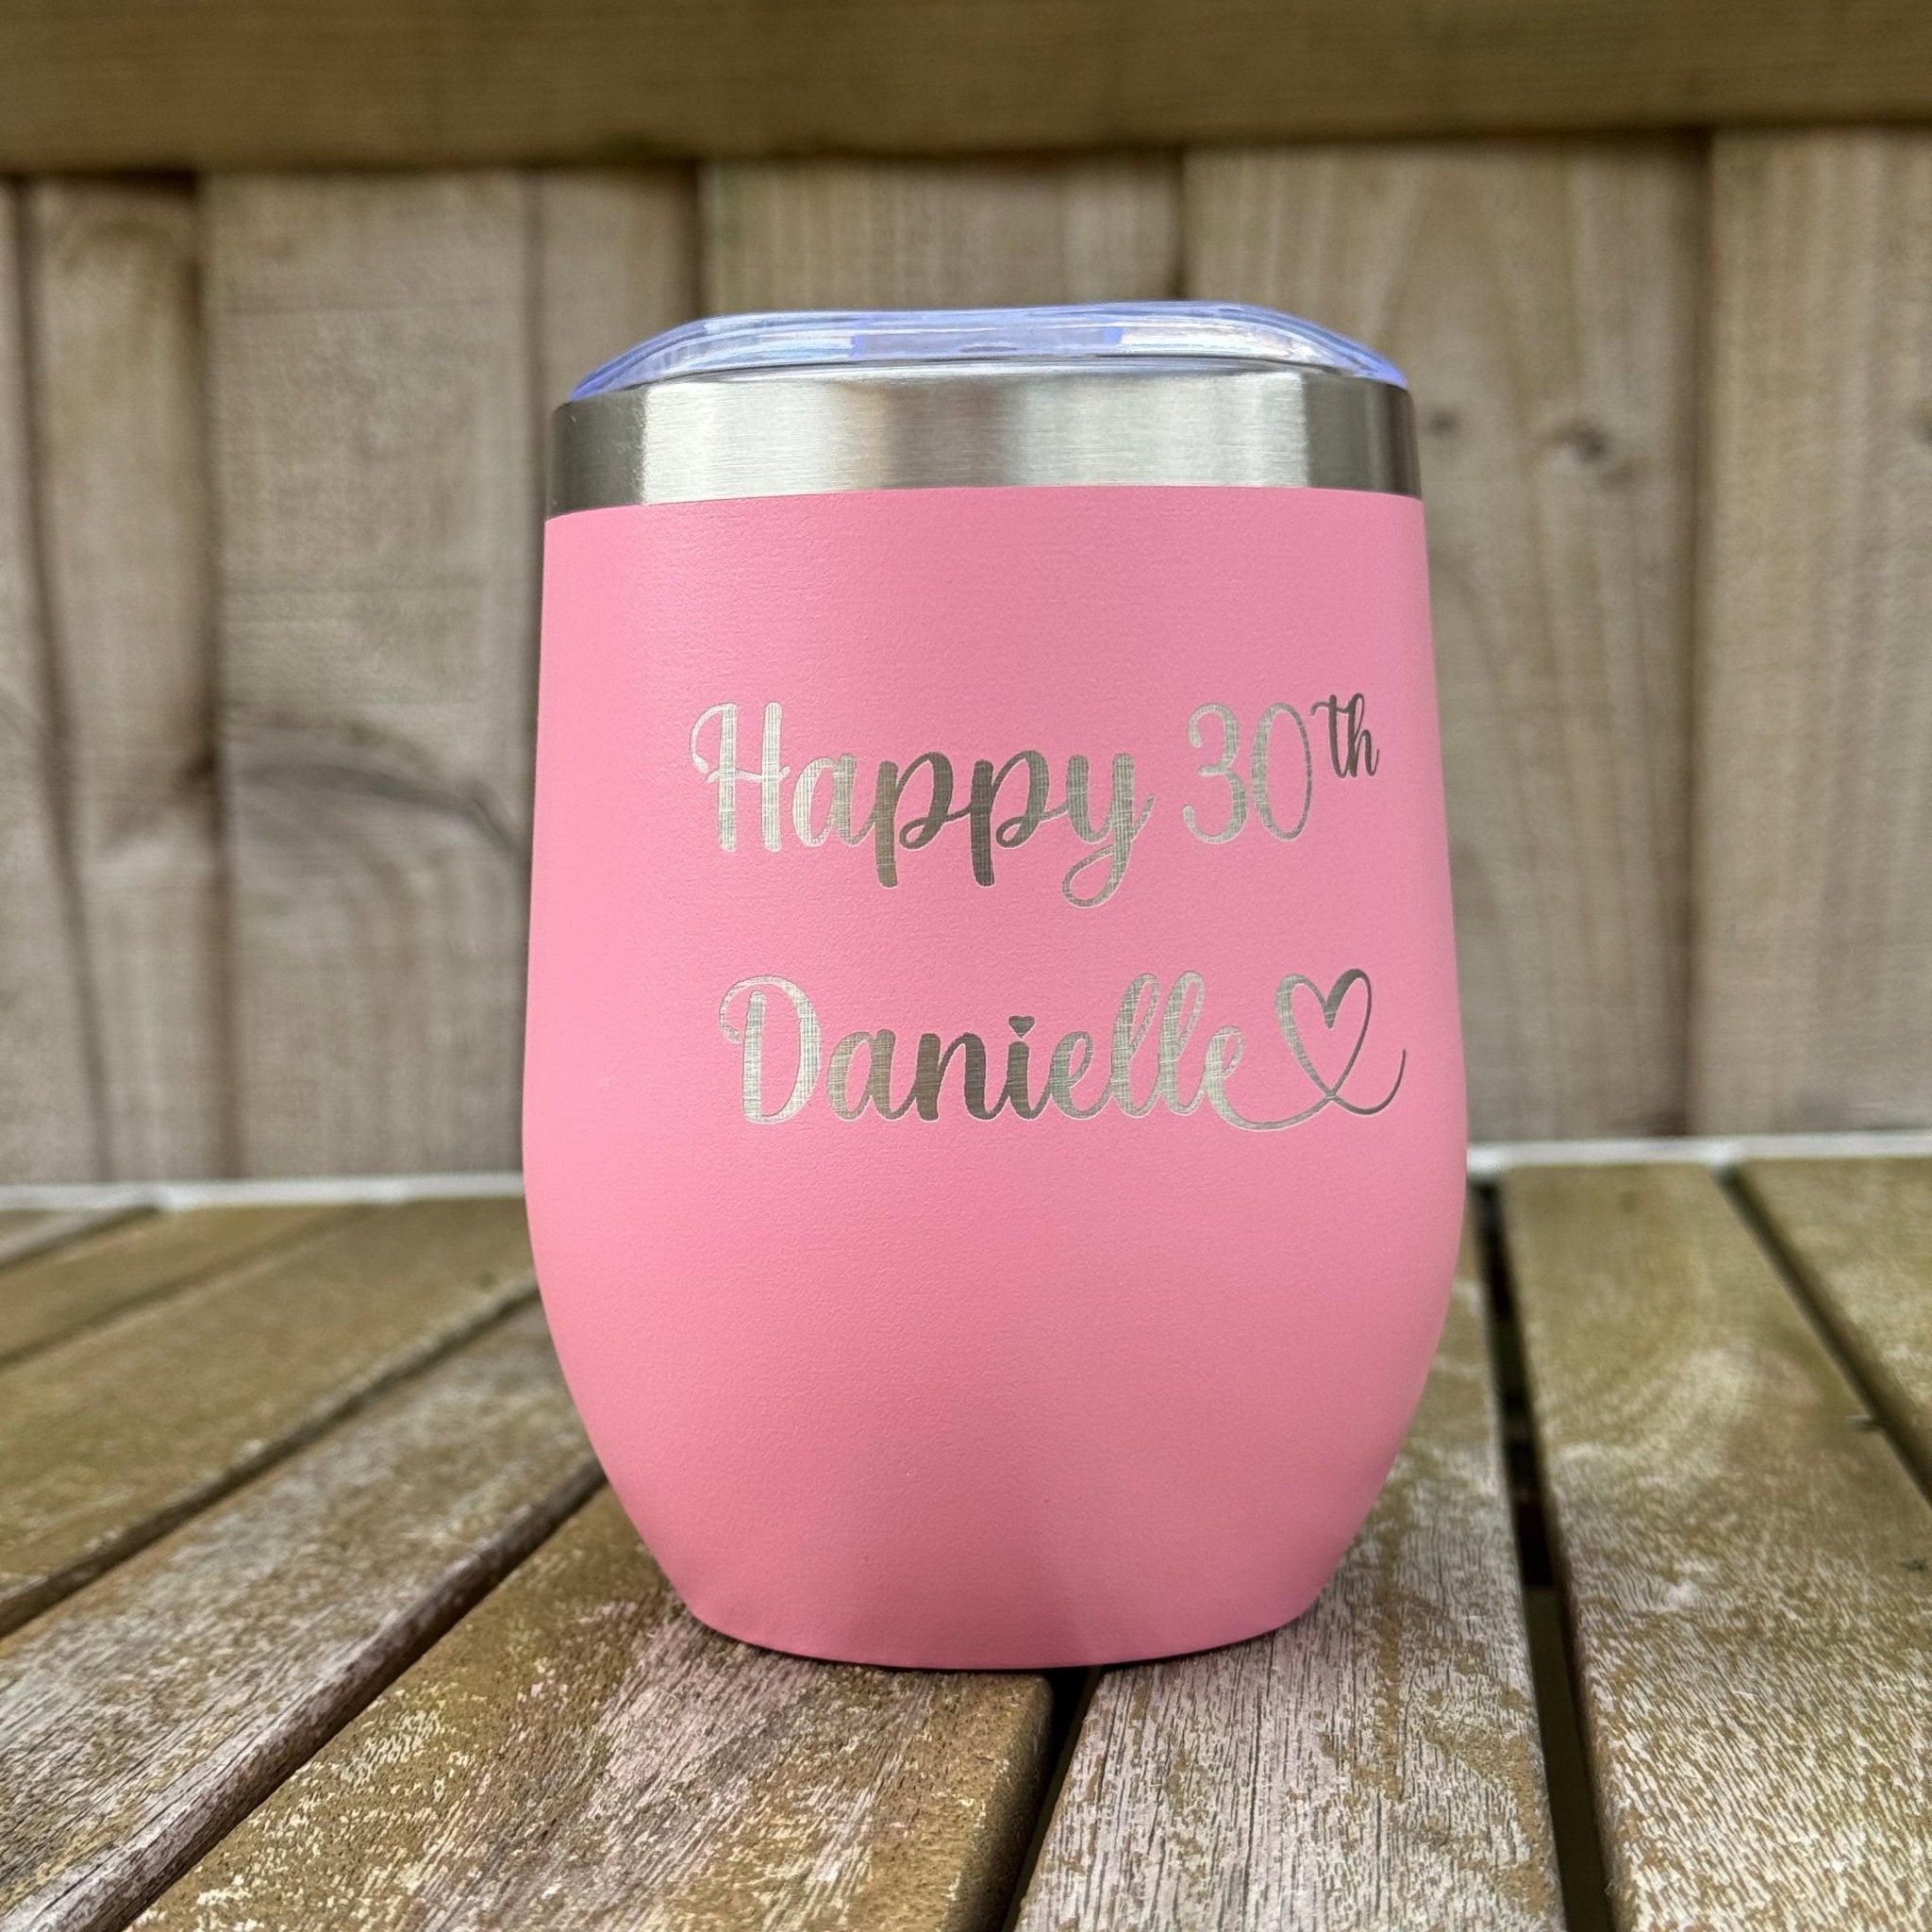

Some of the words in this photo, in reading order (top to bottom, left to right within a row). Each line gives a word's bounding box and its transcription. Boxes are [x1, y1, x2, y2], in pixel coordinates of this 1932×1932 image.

[690, 701, 1155, 908] Happy
[1181, 692, 1380, 846] 30th
[719, 970, 1245, 1130] Danielle
